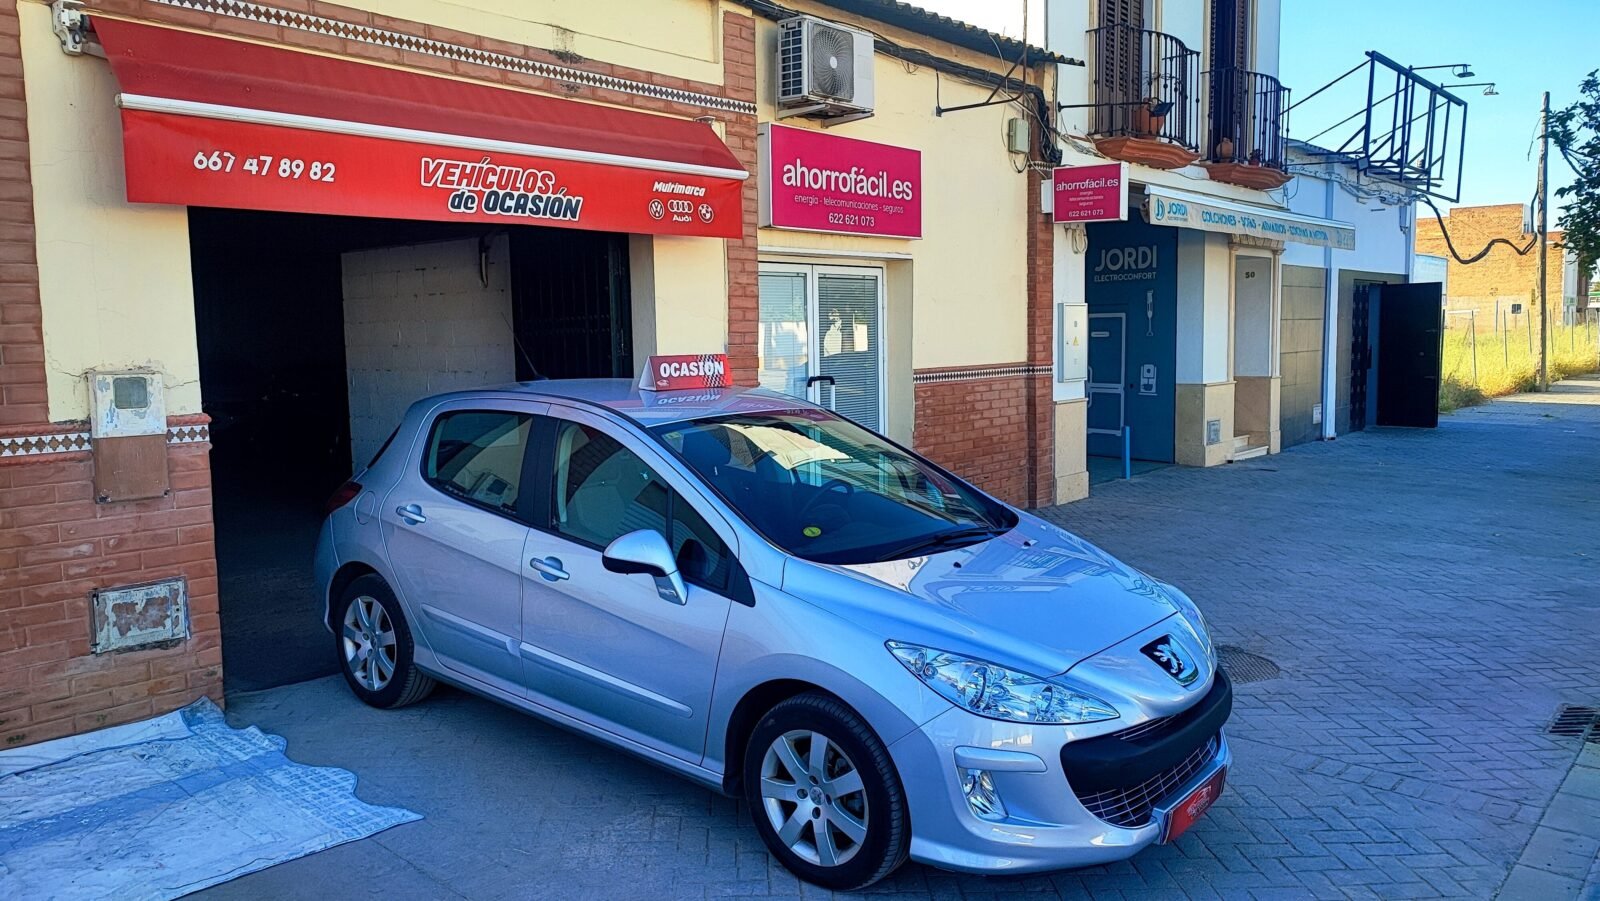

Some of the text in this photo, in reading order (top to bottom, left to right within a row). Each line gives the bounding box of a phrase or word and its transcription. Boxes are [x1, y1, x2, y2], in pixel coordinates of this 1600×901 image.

[193, 151, 336, 182] 667 47 89 82
[421, 157, 555, 195] VEHÍCULOS
[783, 158, 913, 201] ahorrofácil.es
[1056, 178, 1119, 191] ahorrofácil.es
[448, 187, 584, 222] de OCASIÓN
[823, 196, 879, 211] telecomunicaciones
[882, 203, 904, 214] seguros
[1167, 202, 1188, 216] JORDI
[673, 214, 692, 222] Audi
[828, 212, 875, 227] 622 621 073
[1094, 245, 1157, 271] JORDI
[1094, 271, 1157, 282] ELECTROCONFORT
[1245, 271, 1256, 279] 50
